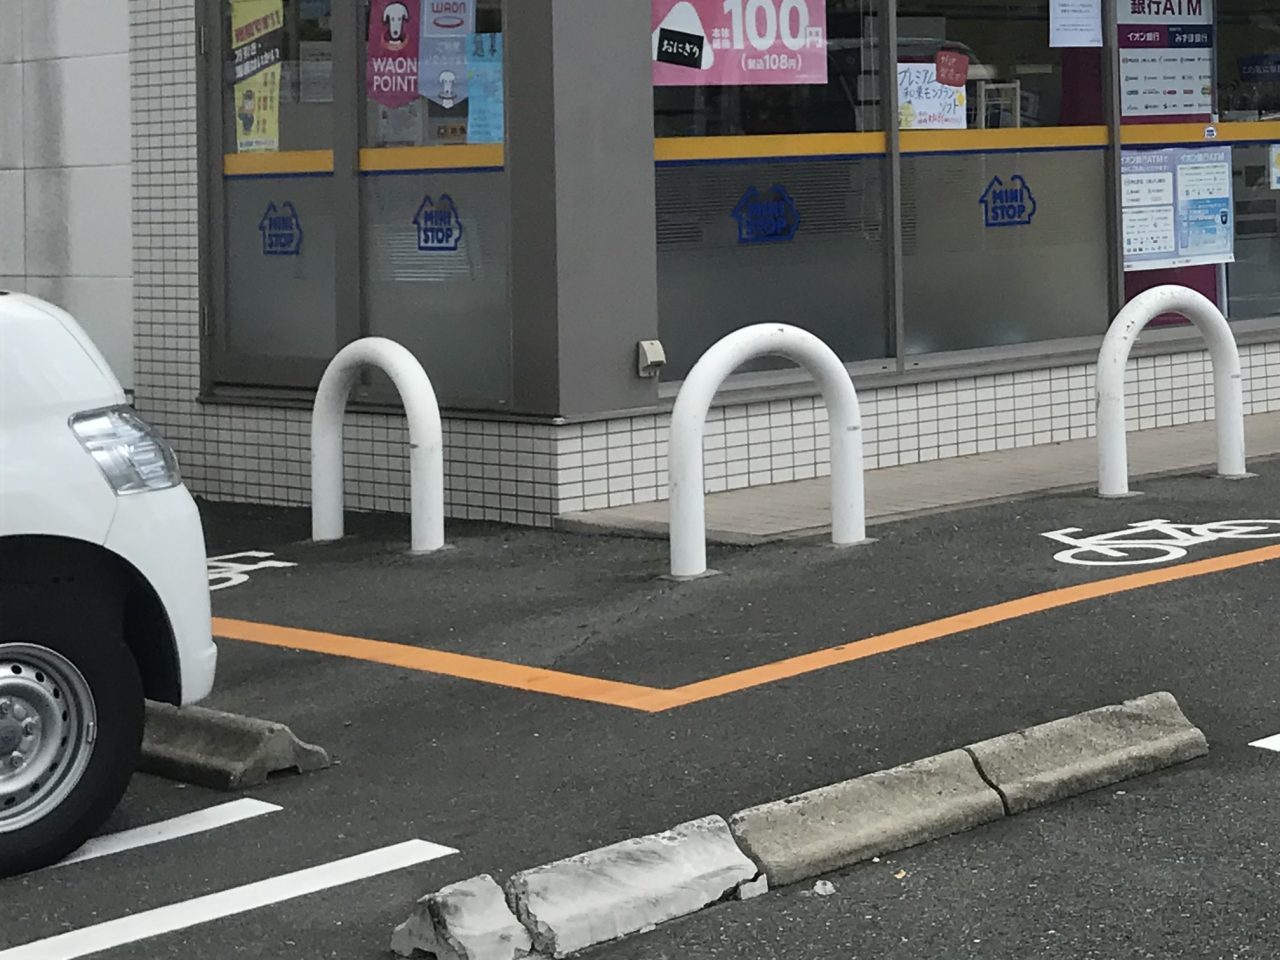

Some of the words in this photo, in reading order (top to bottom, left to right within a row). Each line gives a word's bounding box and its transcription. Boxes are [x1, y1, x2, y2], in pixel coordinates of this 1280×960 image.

[1127, 31, 1160, 41] イオン銀行
[661, 39, 700, 59] おにぎり
[372, 57, 418, 73] WAON
[372, 75, 418, 92] POINT
[991, 205, 1026, 221] STOP
[423, 228, 454, 244] STOP
